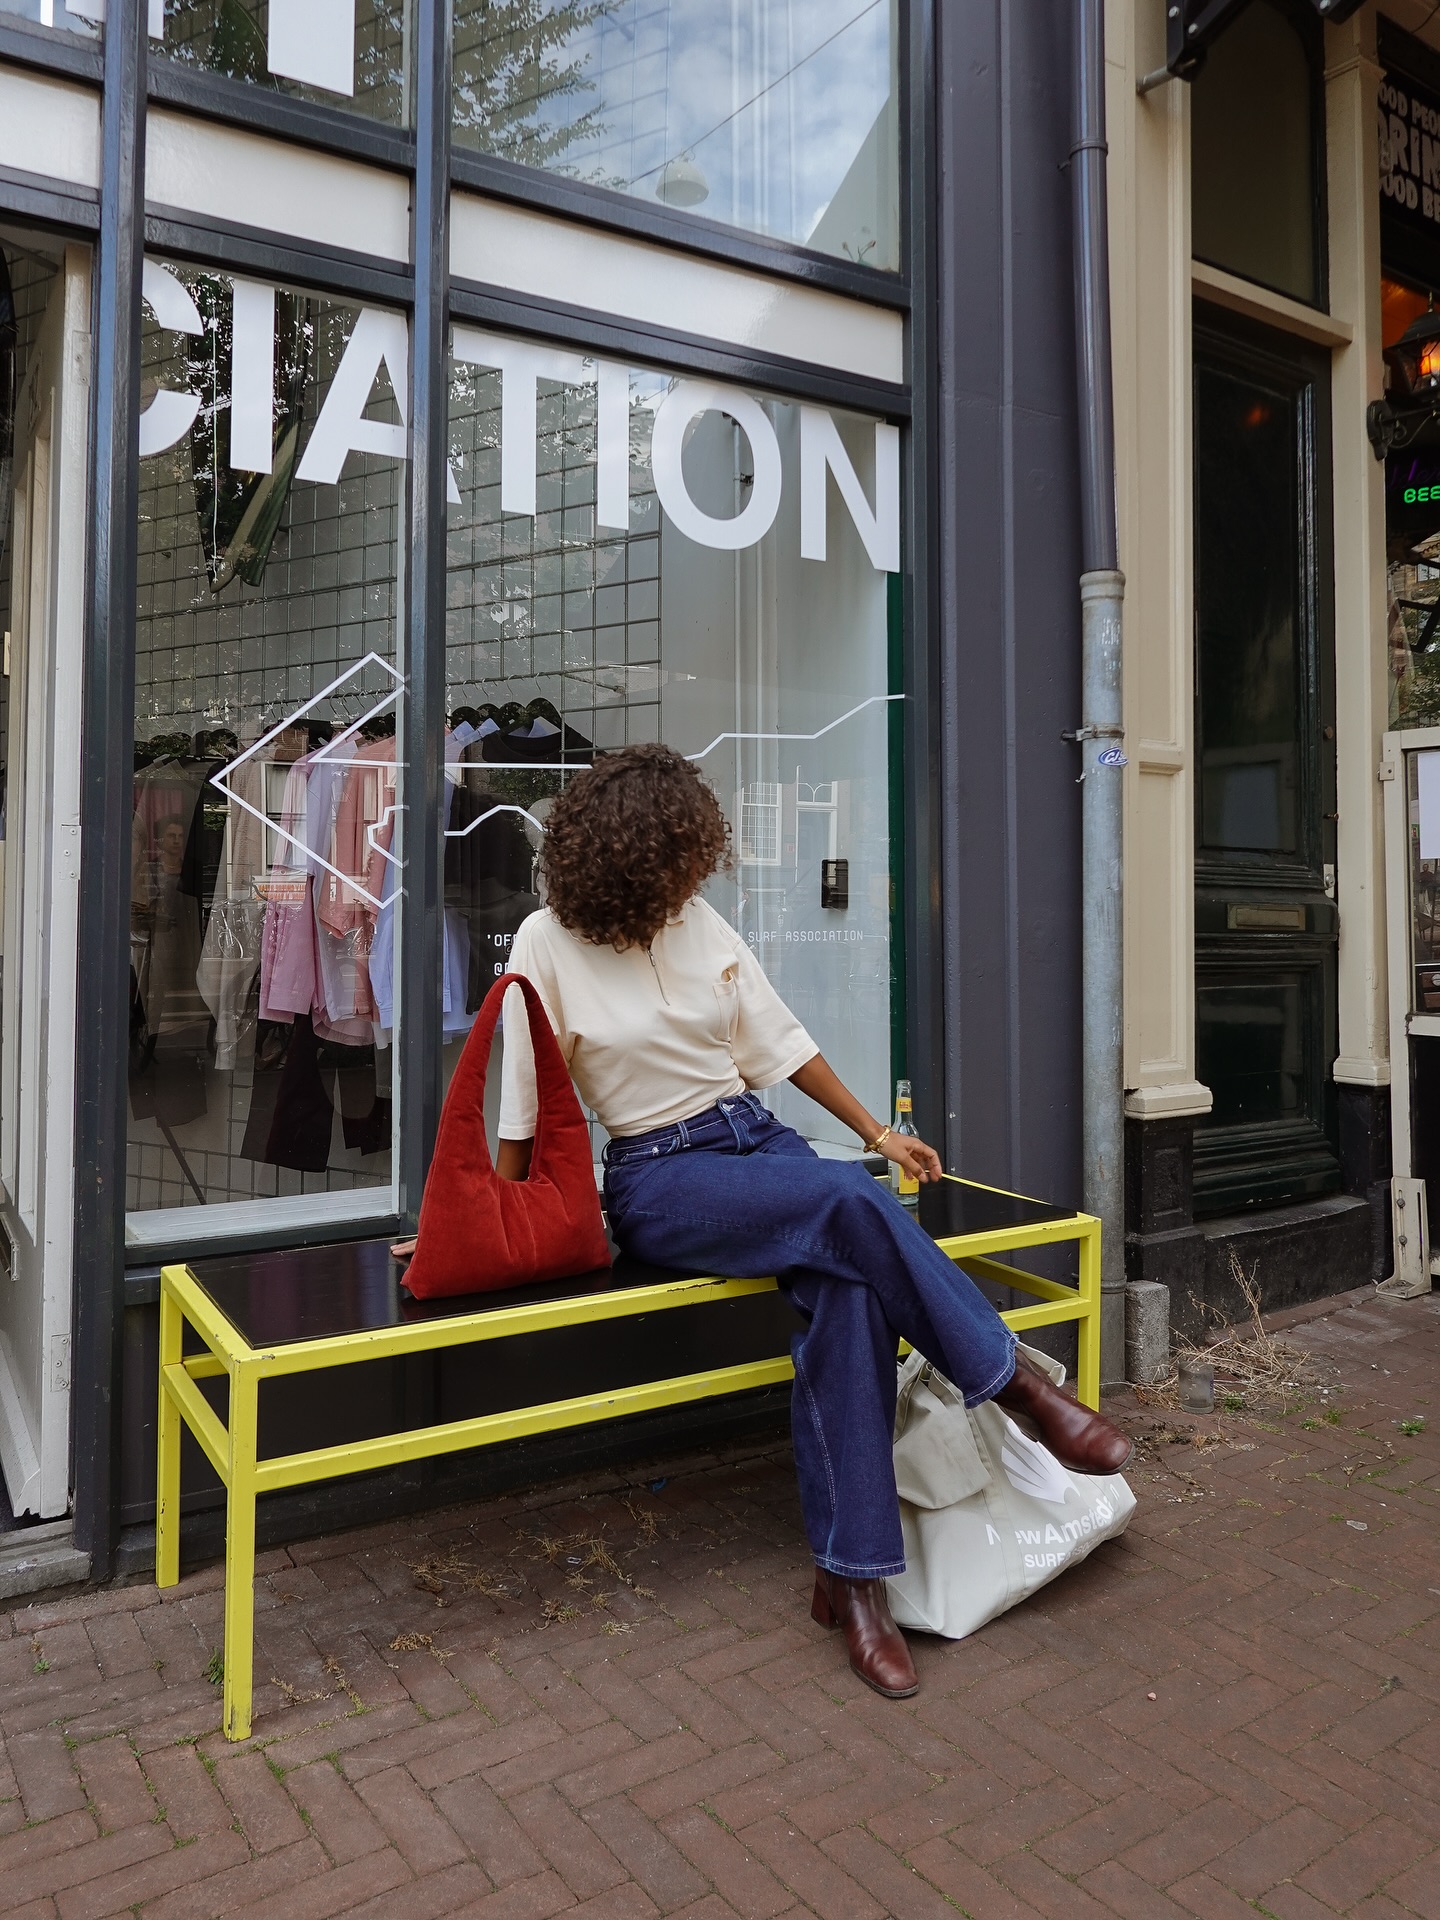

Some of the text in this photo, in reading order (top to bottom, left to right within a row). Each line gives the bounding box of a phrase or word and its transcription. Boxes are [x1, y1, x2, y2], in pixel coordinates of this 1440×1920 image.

[1411, 97, 1440, 138] PEO
[1379, 173, 1418, 210] OOD
[747, 930, 777, 943] SURF
[785, 930, 863, 942] ASSOCIATION
